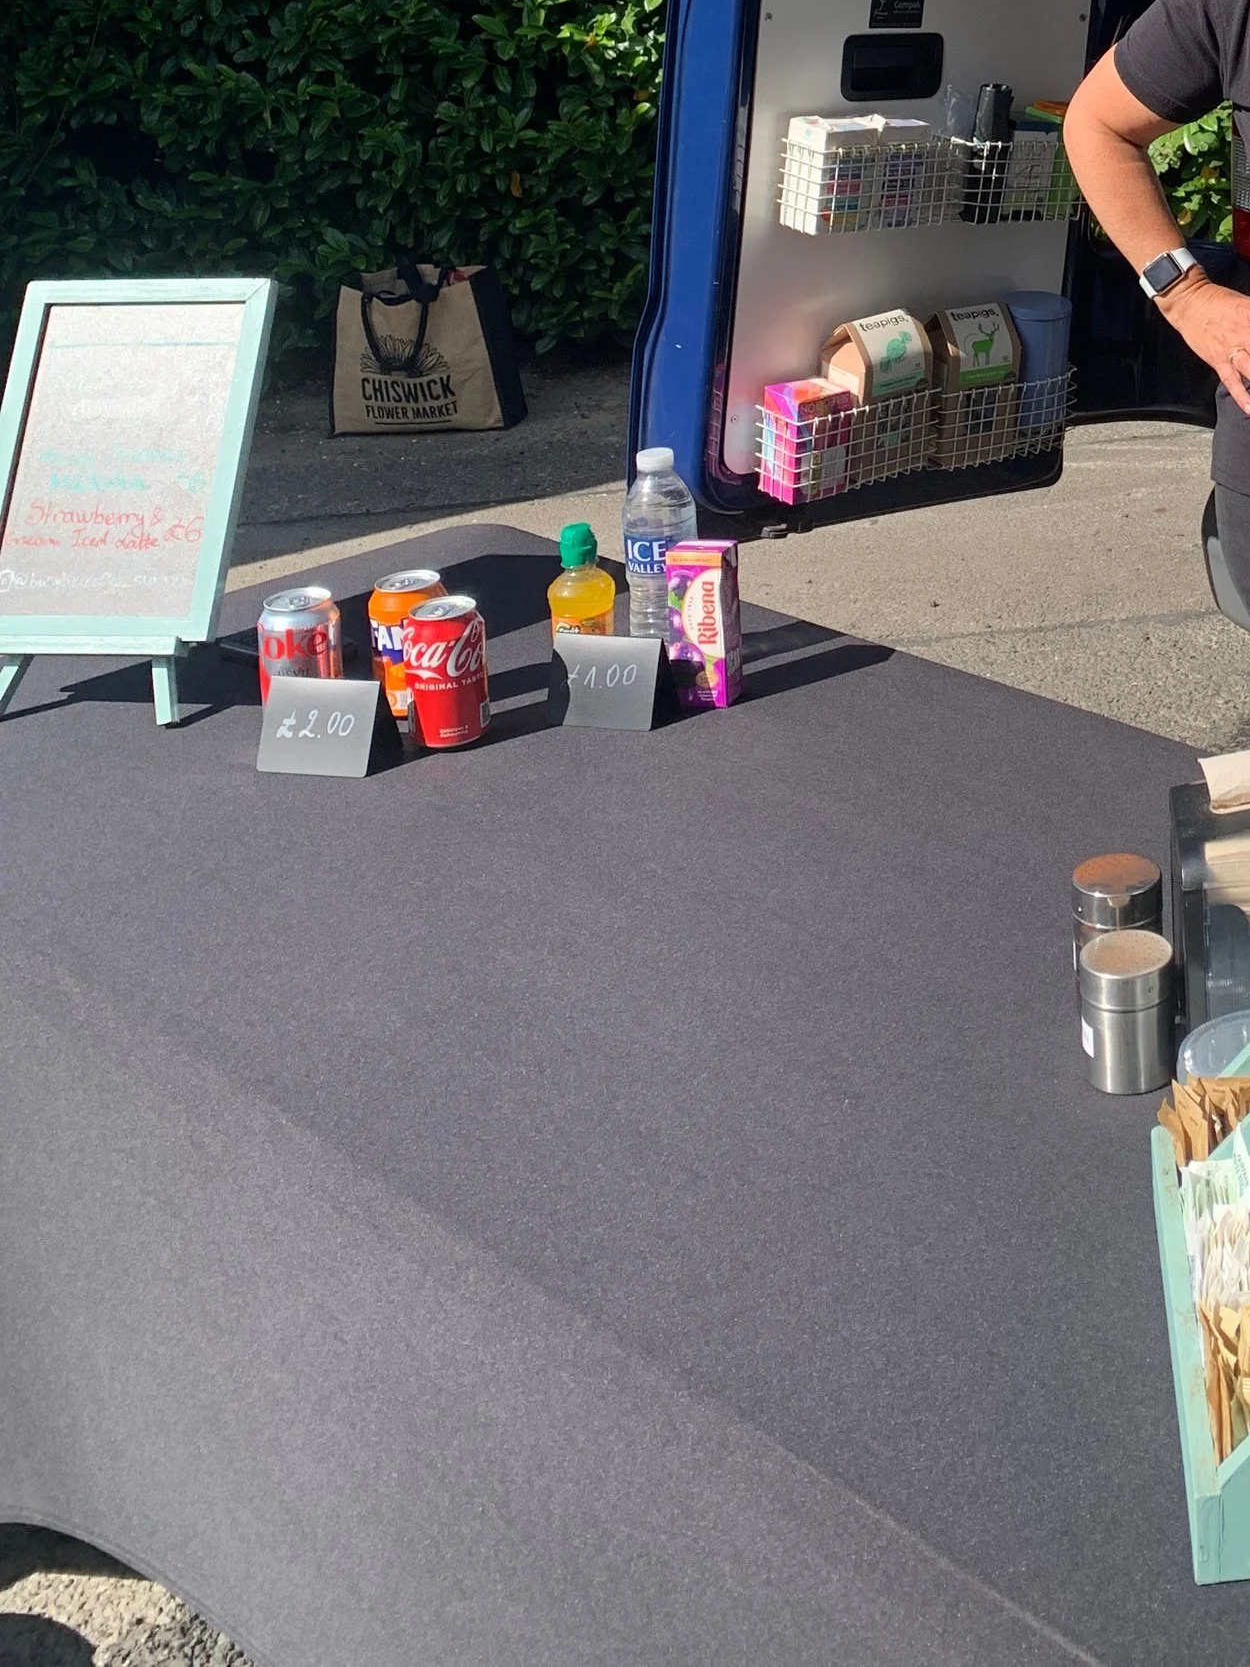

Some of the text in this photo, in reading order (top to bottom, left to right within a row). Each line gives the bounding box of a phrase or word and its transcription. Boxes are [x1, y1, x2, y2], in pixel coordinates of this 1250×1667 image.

[361, 374, 456, 404] CHISWICK
[365, 400, 458, 420] FLOWER MARKET
[25, 501, 163, 539] Strawberry &
[71, 528, 110, 549] Iced
[163, 516, 205, 543] £6
[626, 538, 667, 562] ICE
[627, 562, 668, 575] VALLEY
[697, 580, 717, 646] Ribena
[258, 622, 328, 660] oke
[370, 619, 404, 652] FAN
[403, 620, 487, 677] Coca-Co
[415, 680, 459, 692] ORIGINAL
[561, 663, 638, 689] £1.00
[276, 709, 356, 739] £2.00
